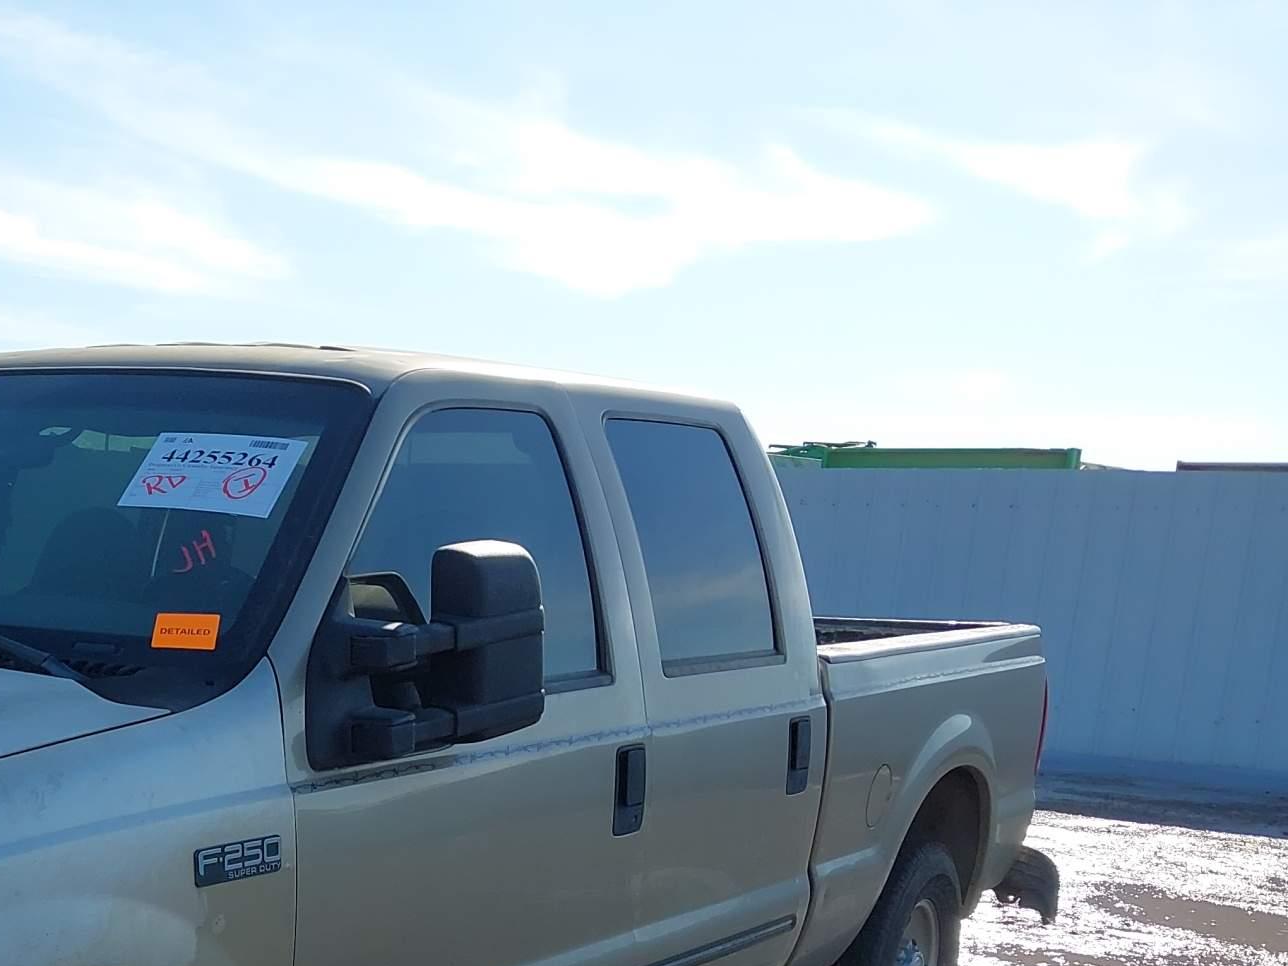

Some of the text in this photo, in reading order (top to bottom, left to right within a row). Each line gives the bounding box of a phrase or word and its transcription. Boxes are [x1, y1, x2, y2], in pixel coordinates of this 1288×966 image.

[162, 449, 278, 468] 44255264
[159, 627, 211, 637] DETAILED
[228, 861, 281, 879] SUPER DUTY
